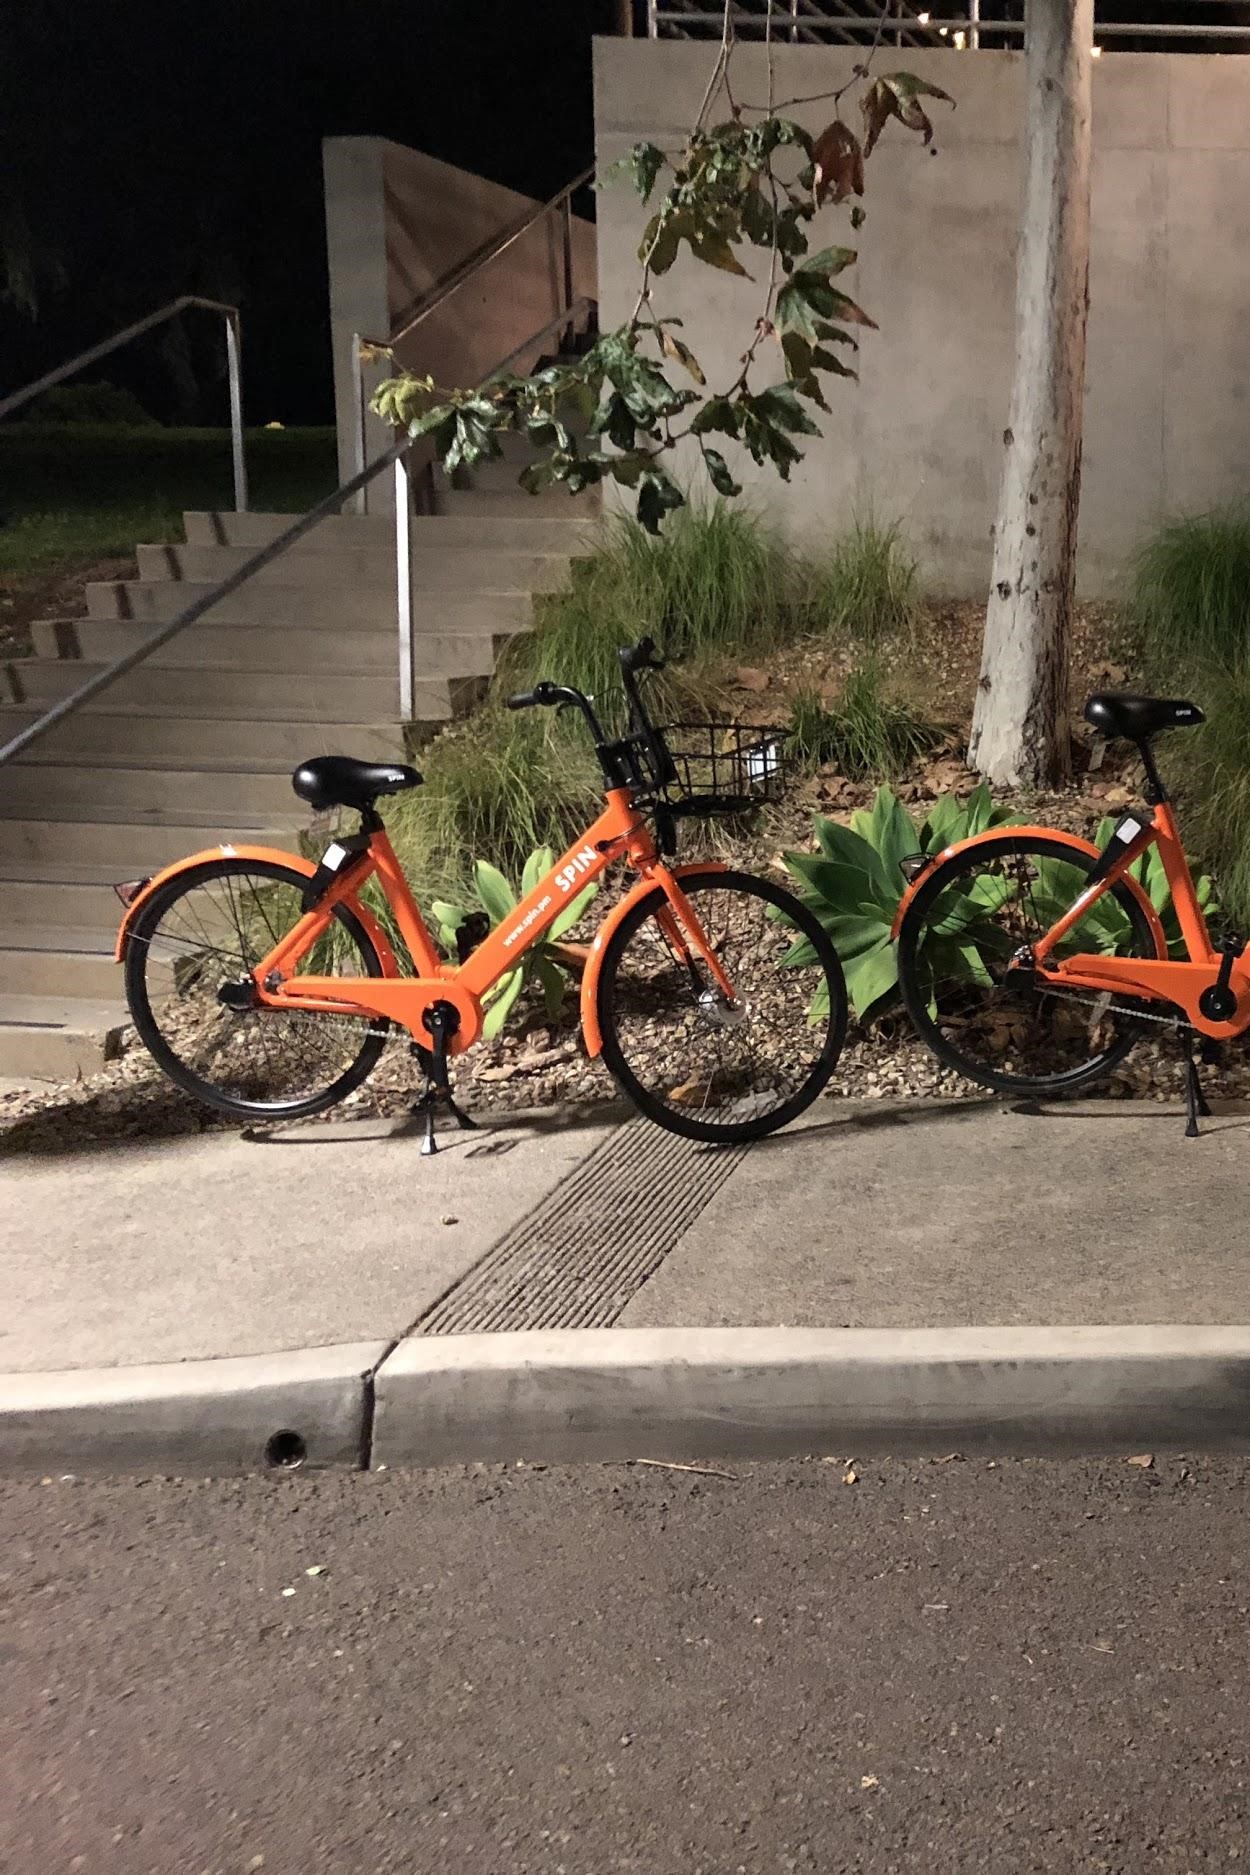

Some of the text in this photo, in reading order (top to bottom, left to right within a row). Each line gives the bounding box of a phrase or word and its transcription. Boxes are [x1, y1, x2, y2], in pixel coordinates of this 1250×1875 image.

[388, 774, 405, 782] SPIN
[554, 846, 598, 893] SPIN
[503, 896, 552, 947] www.spin.pm
